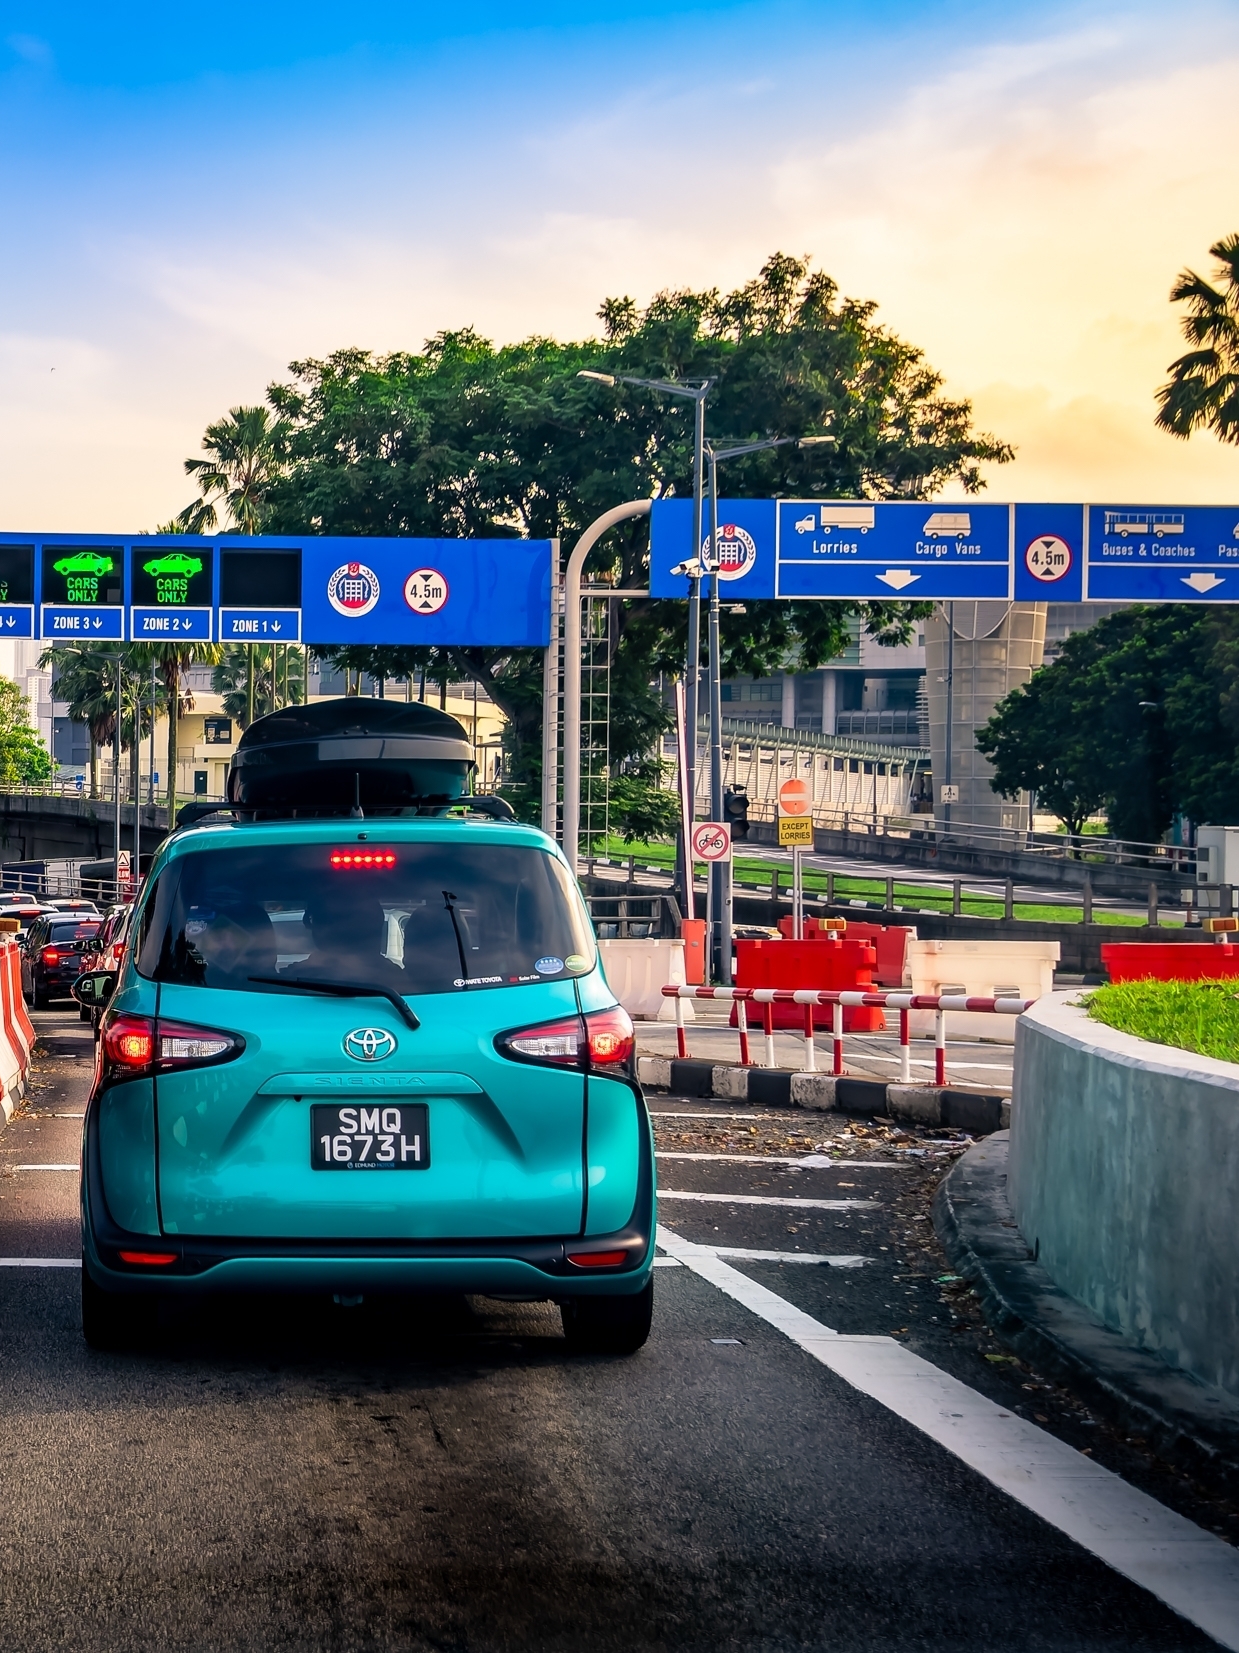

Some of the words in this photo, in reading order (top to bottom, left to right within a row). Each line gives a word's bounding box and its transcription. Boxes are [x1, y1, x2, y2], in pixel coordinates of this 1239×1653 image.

[813, 540, 858, 554] Lorries
[916, 541, 948, 558] Cargo
[955, 542, 981, 555] Vans
[1103, 543, 1133, 556] Buses
[1139, 543, 1147, 556] &
[1152, 543, 1195, 557] Coaches
[1218, 544, 1239, 557] Pas
[1031, 551, 1064, 566] 4.5m
[66, 577, 98, 589] CARS
[156, 578, 188, 590] CARS
[67, 590, 98, 602] ONLY
[157, 591, 188, 603] ONLY
[410, 584, 442, 599] 4.5m
[53, 617, 80, 629] ZONE
[83, 617, 90, 629] 3
[143, 618, 169, 630] ZONE
[172, 618, 179, 631] 2
[232, 620, 259, 633] ZONE
[262, 620, 267, 632] 1
[782, 822, 808, 830] EXCEPT
[780, 832, 810, 840] LORRIES
[481, 975, 502, 984] TOYOTA
[314, 1076, 426, 1085] SIENTA
[339, 1108, 401, 1134] SMQ
[320, 1135, 421, 1161] 1673H
